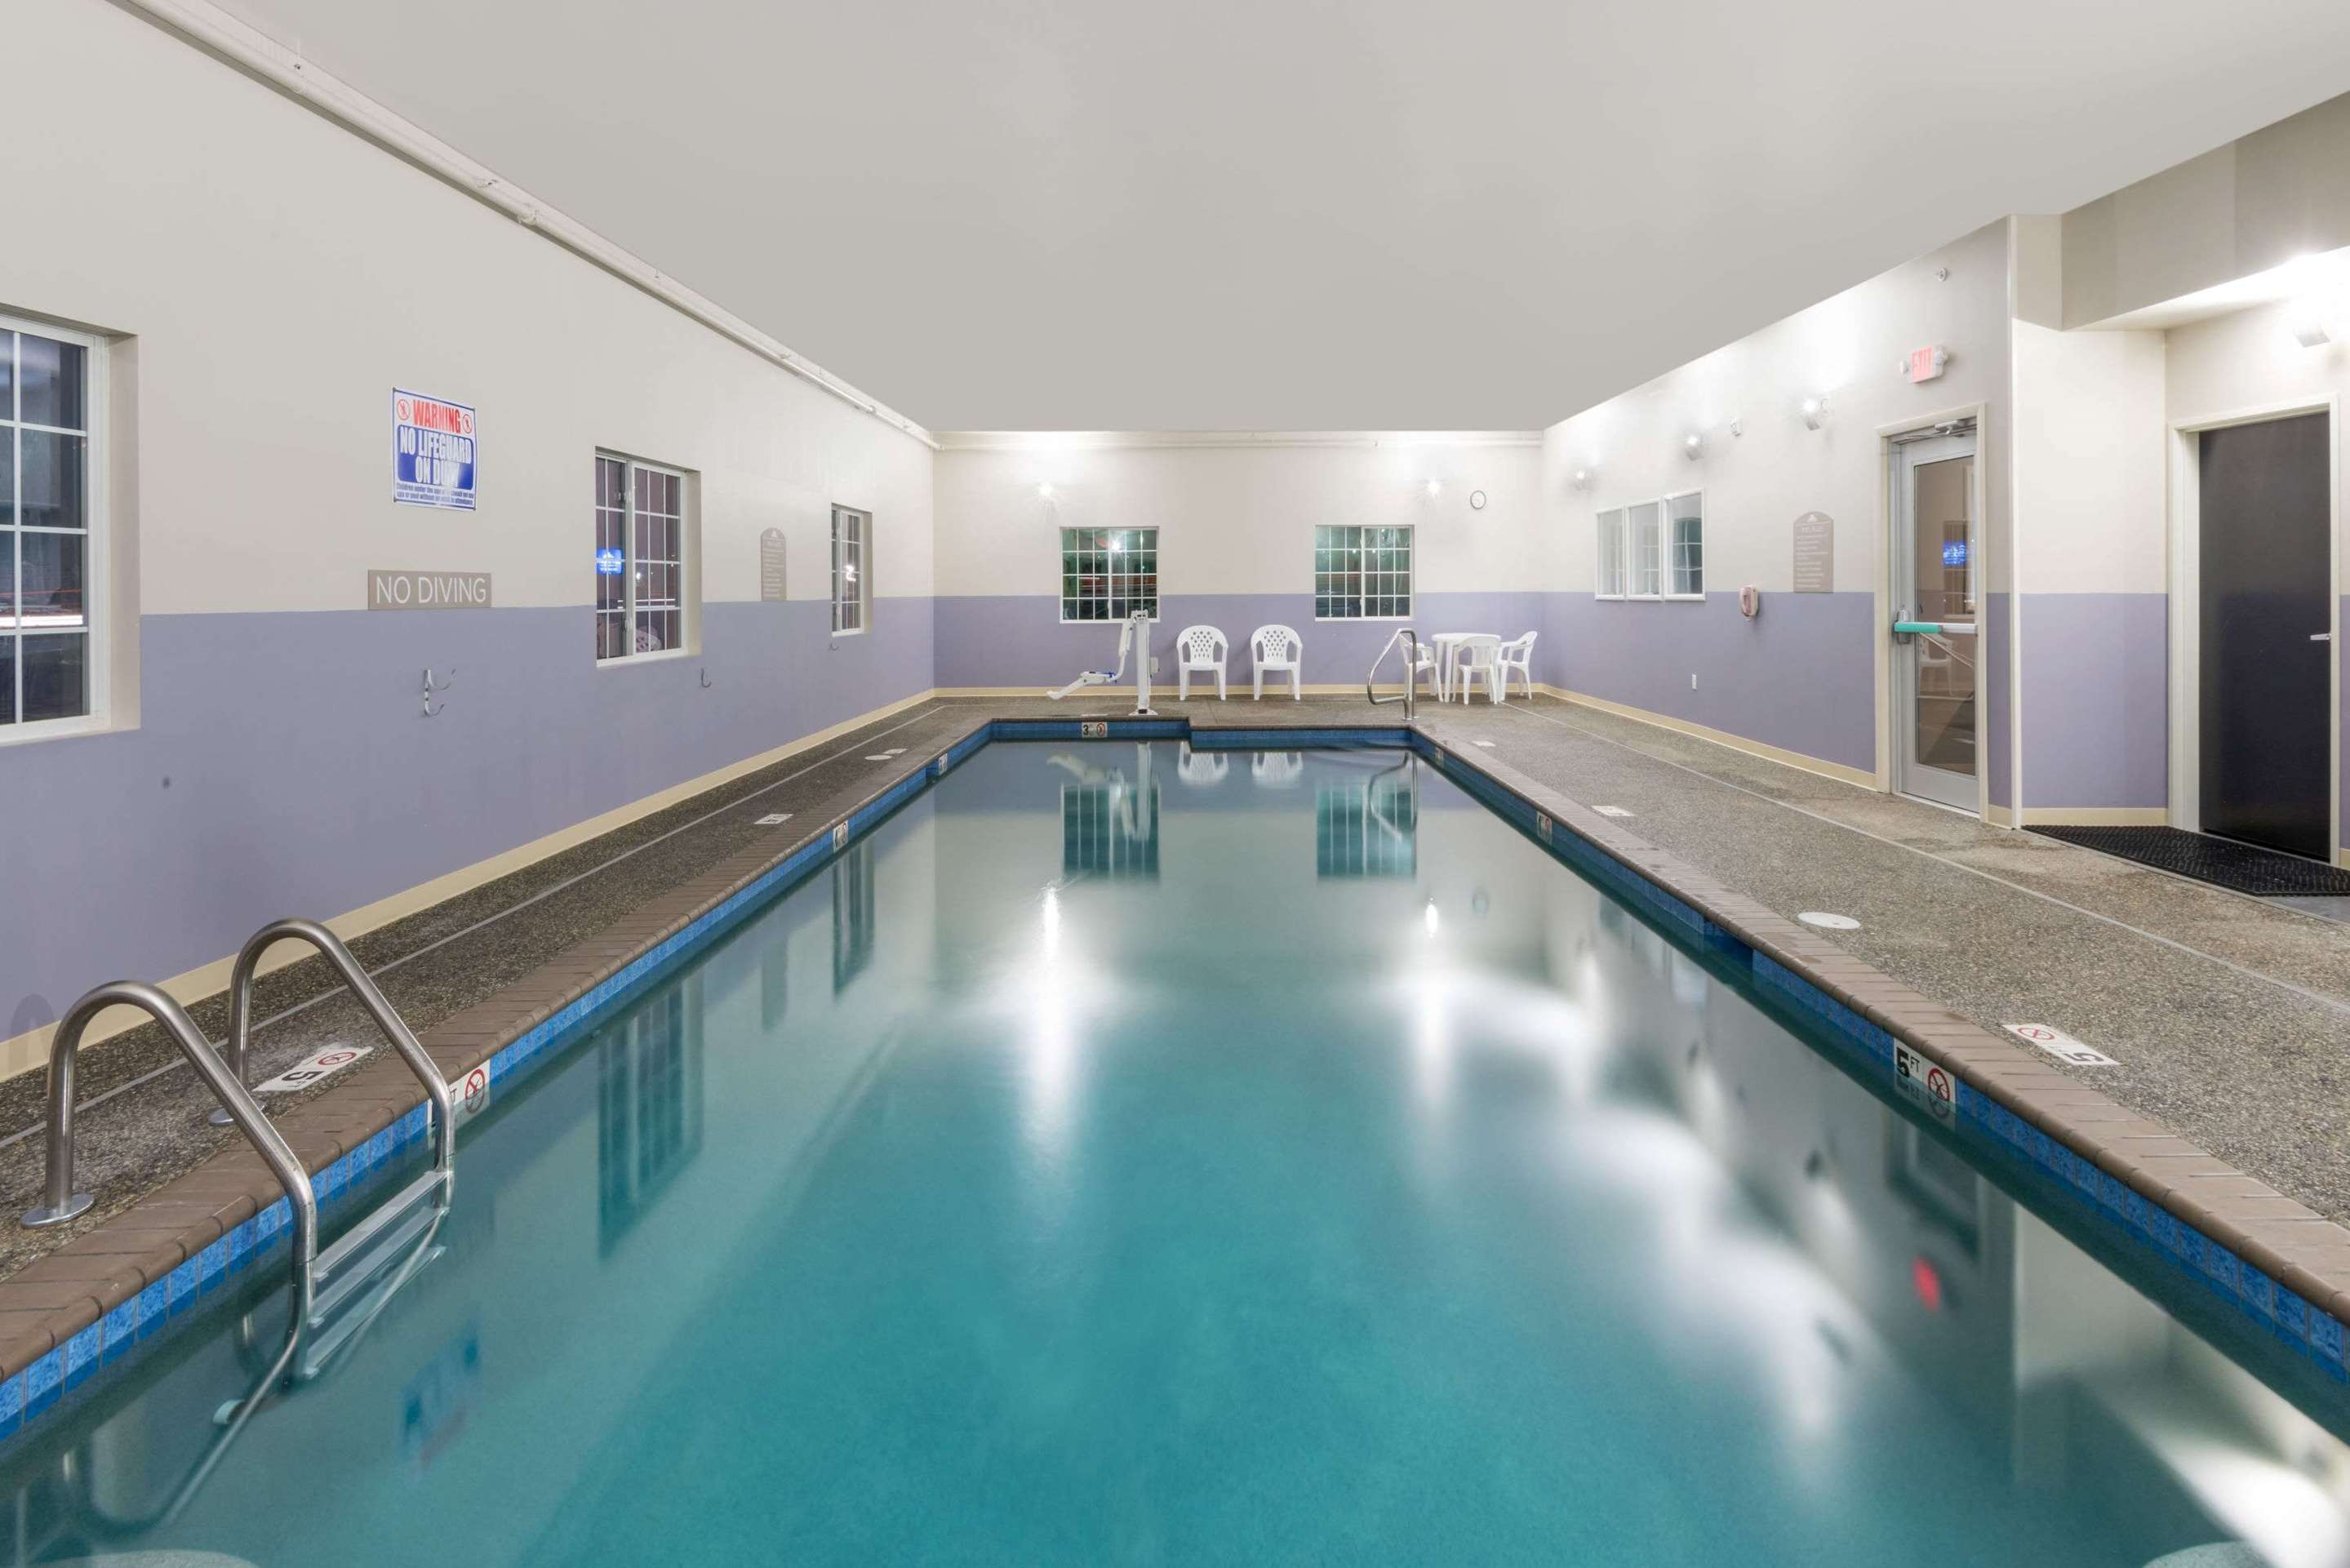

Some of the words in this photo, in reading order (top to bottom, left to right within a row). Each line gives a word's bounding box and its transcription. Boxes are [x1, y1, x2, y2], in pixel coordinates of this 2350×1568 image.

[412, 399, 460, 433] WARNING
[400, 427, 415, 455] NO
[418, 430, 472, 464] LIFEGUARD
[415, 456, 431, 484] ON
[433, 459, 460, 488] DU
[376, 575, 411, 604] NO
[418, 576, 486, 603] DIVING
[1897, 1047, 1909, 1078] 5
[1911, 1056, 1920, 1073] FT
[2063, 1052, 2103, 1062] 5
[282, 1070, 325, 1082] 5
